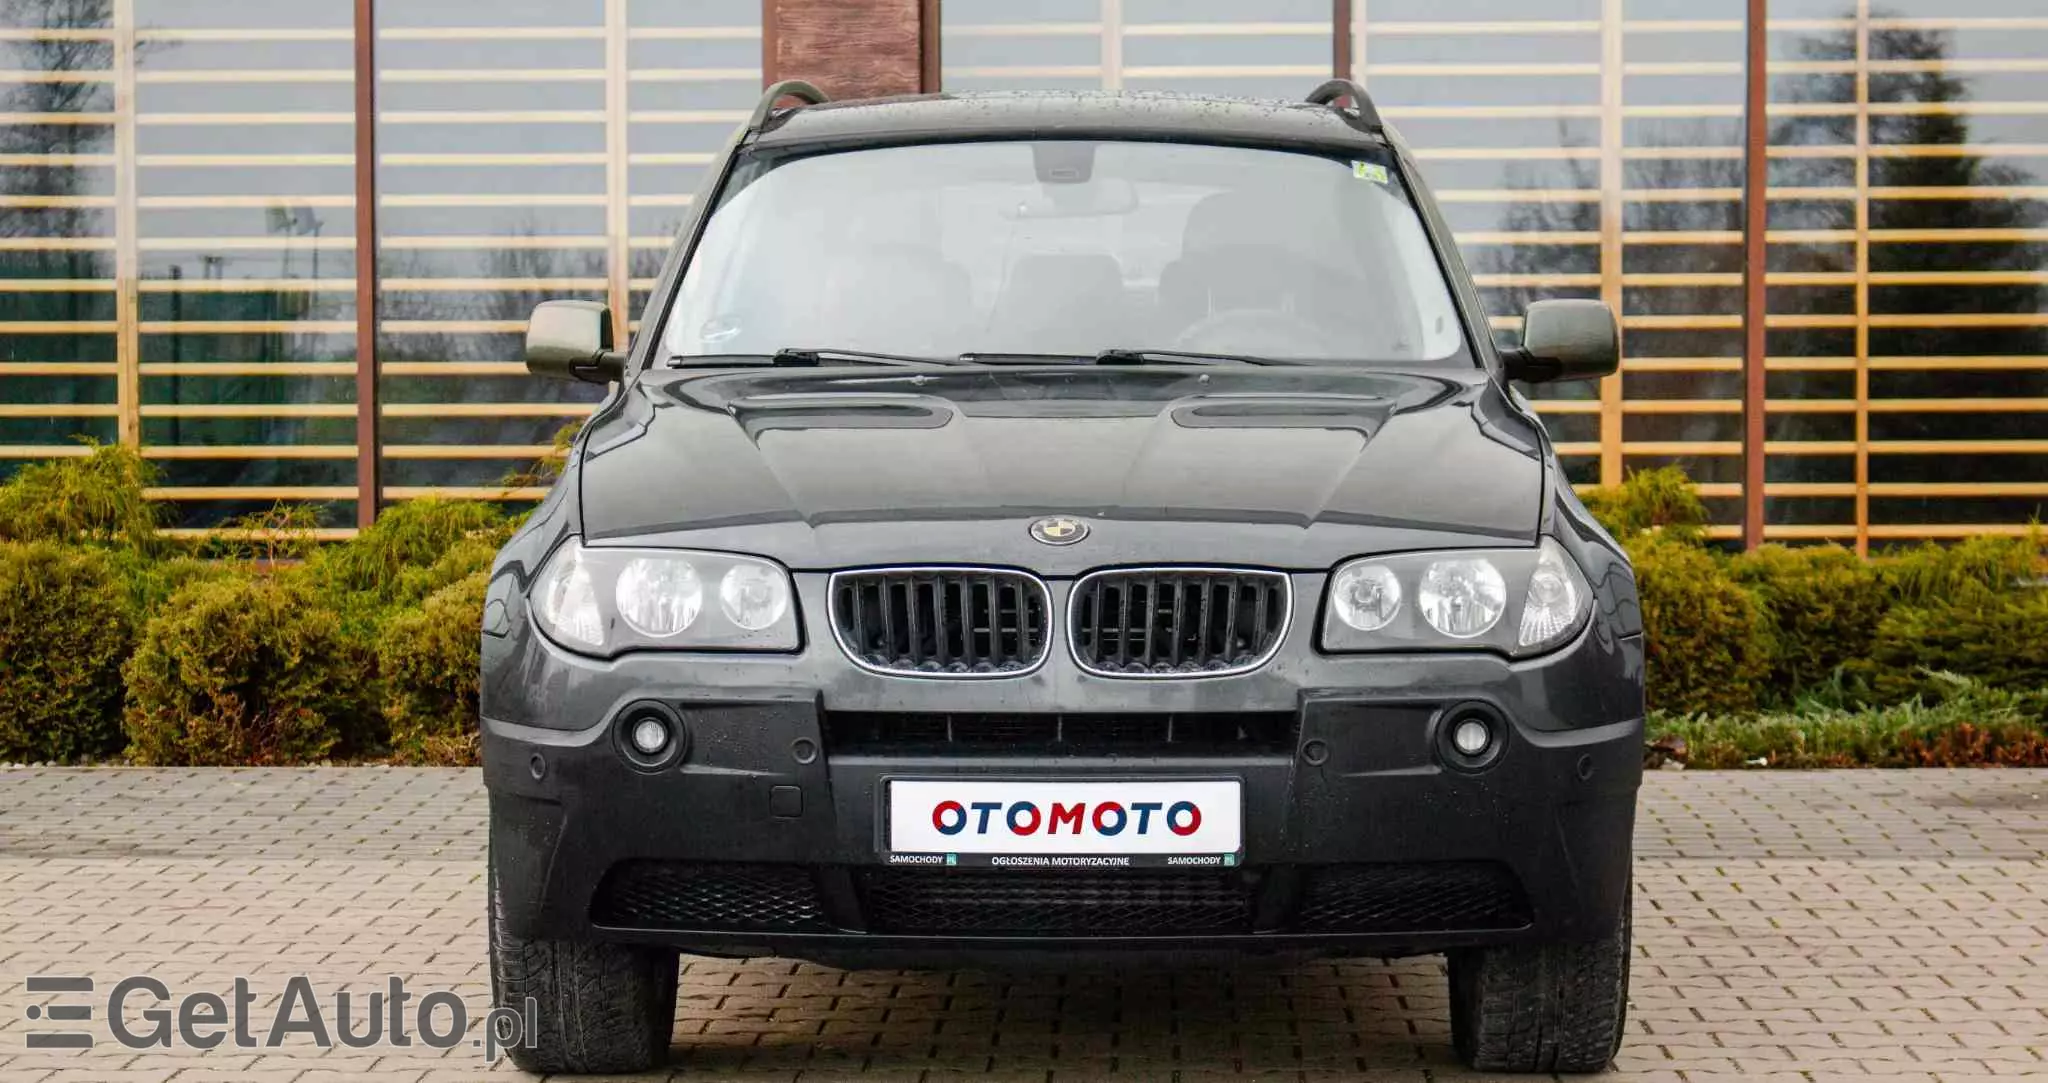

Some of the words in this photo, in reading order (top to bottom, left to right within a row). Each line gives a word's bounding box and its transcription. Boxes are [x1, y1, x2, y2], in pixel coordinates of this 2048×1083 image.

[932, 800, 1202, 836] OTOMOTO
[889, 855, 943, 865] SAMOCHODY
[991, 856, 1049, 866] OGŁOSZENIA
[1051, 857, 1130, 867] MOTORYZACYJNE
[1167, 856, 1221, 866] SAMOCHODY
